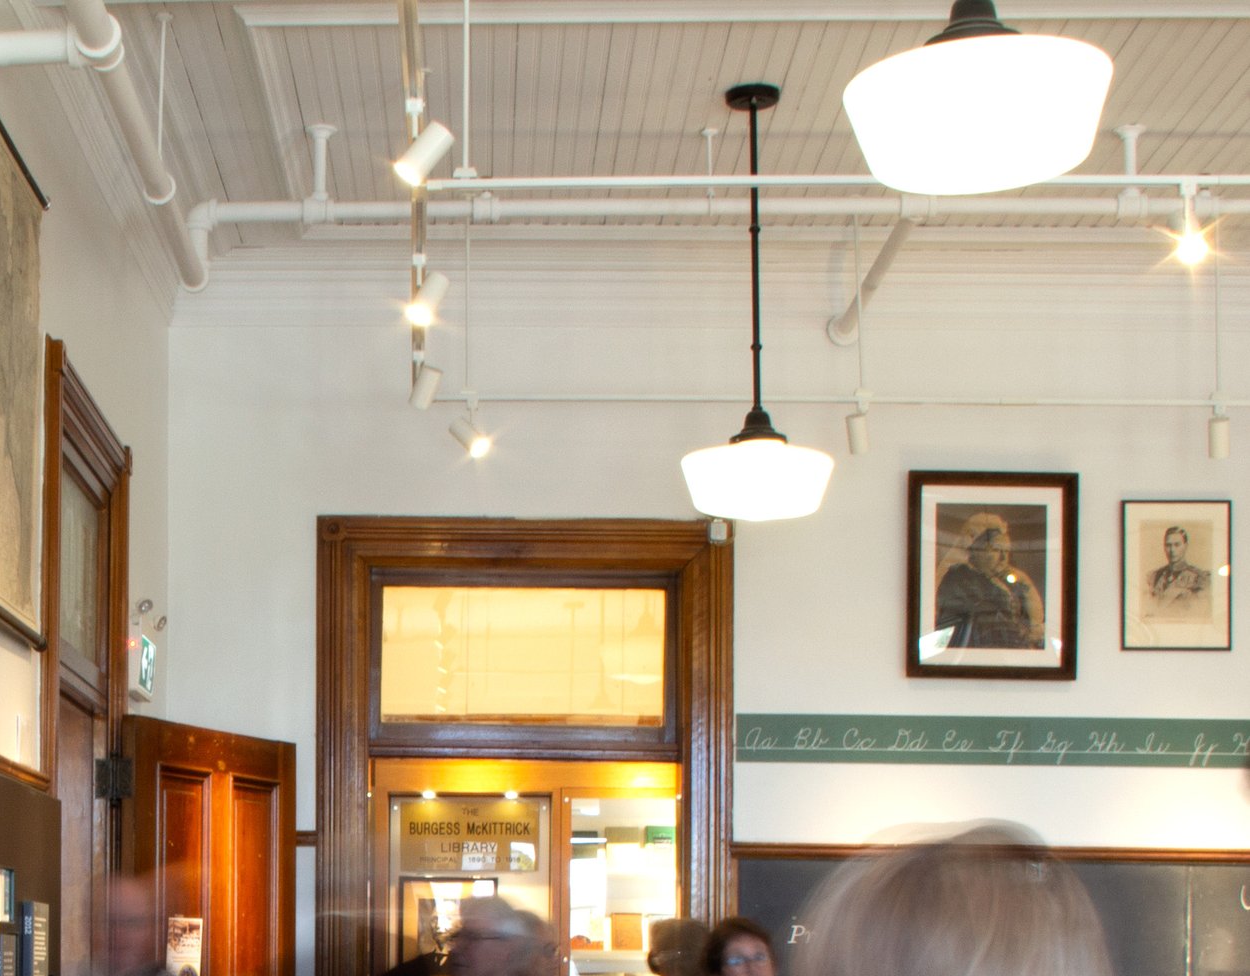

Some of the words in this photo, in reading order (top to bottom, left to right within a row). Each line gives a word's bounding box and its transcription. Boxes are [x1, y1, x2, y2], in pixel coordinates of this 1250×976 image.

[409, 821, 460, 836] BURGESS
[466, 821, 531, 836] McKITTRICK
[440, 841, 497, 854] LIBRARY
